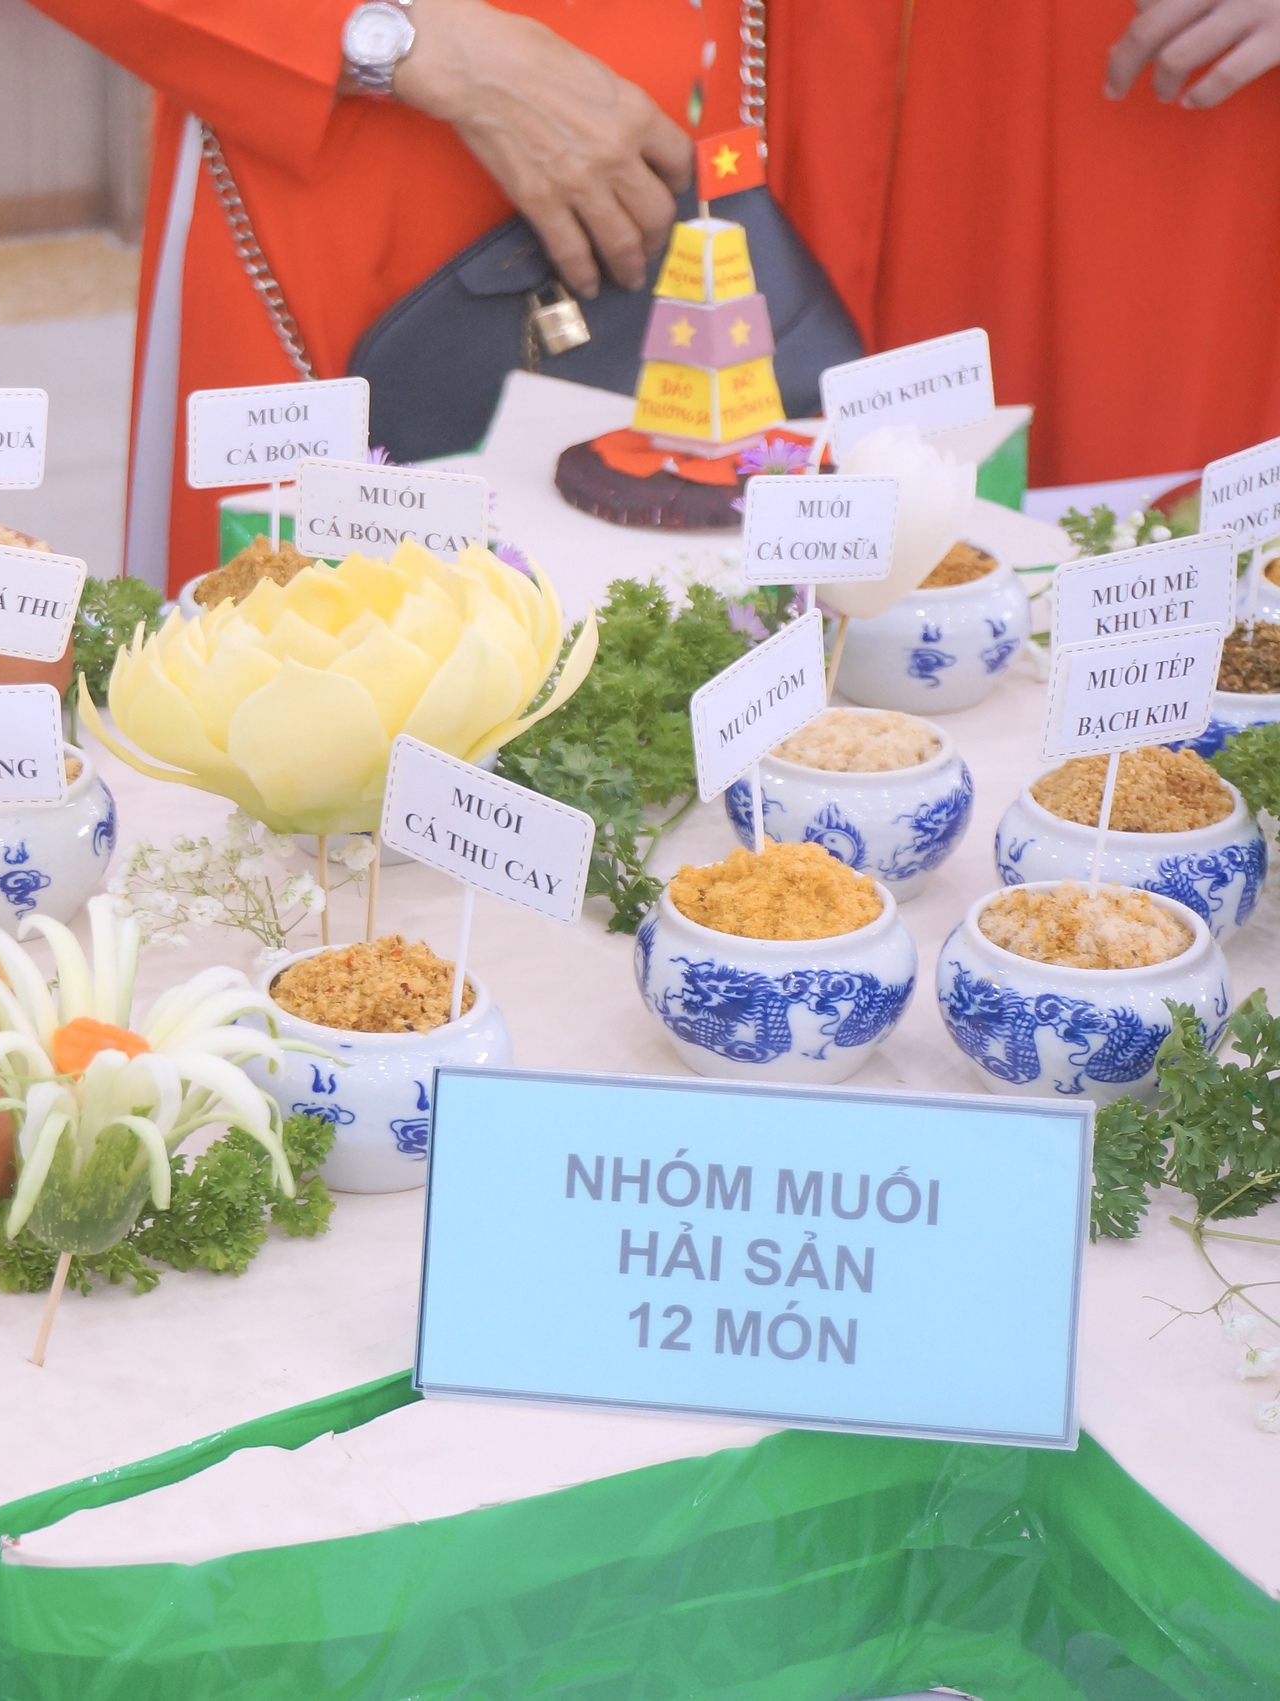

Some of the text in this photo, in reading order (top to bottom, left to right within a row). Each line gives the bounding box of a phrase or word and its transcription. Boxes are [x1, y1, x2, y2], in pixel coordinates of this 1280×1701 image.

[247, 401, 310, 427] MUỐI
[226, 442, 258, 466] CÁ
[359, 485, 426, 510] MUỐI
[797, 495, 852, 519] MUỐI
[309, 515, 342, 538] CÁ
[757, 537, 880, 561] CÁ CƠM SỮA
[1092, 564, 1199, 608] MUỐI MÈ
[17, 595, 68, 620] THU
[1095, 598, 1195, 637] KHUYẾT
[1086, 652, 1195, 691] MUỐI TÉP
[719, 667, 806, 748] MUỐI TÔM
[1076, 700, 1190, 739] BẠCH KIM
[451, 787, 524, 836] MUỐI
[406, 813, 562, 896] CÁ THU CAY
[565, 1148, 941, 1226] NHÓM MUỐI
[618, 1220, 875, 1293] HẢI SẢN
[628, 1300, 859, 1365] 12 MÓN
